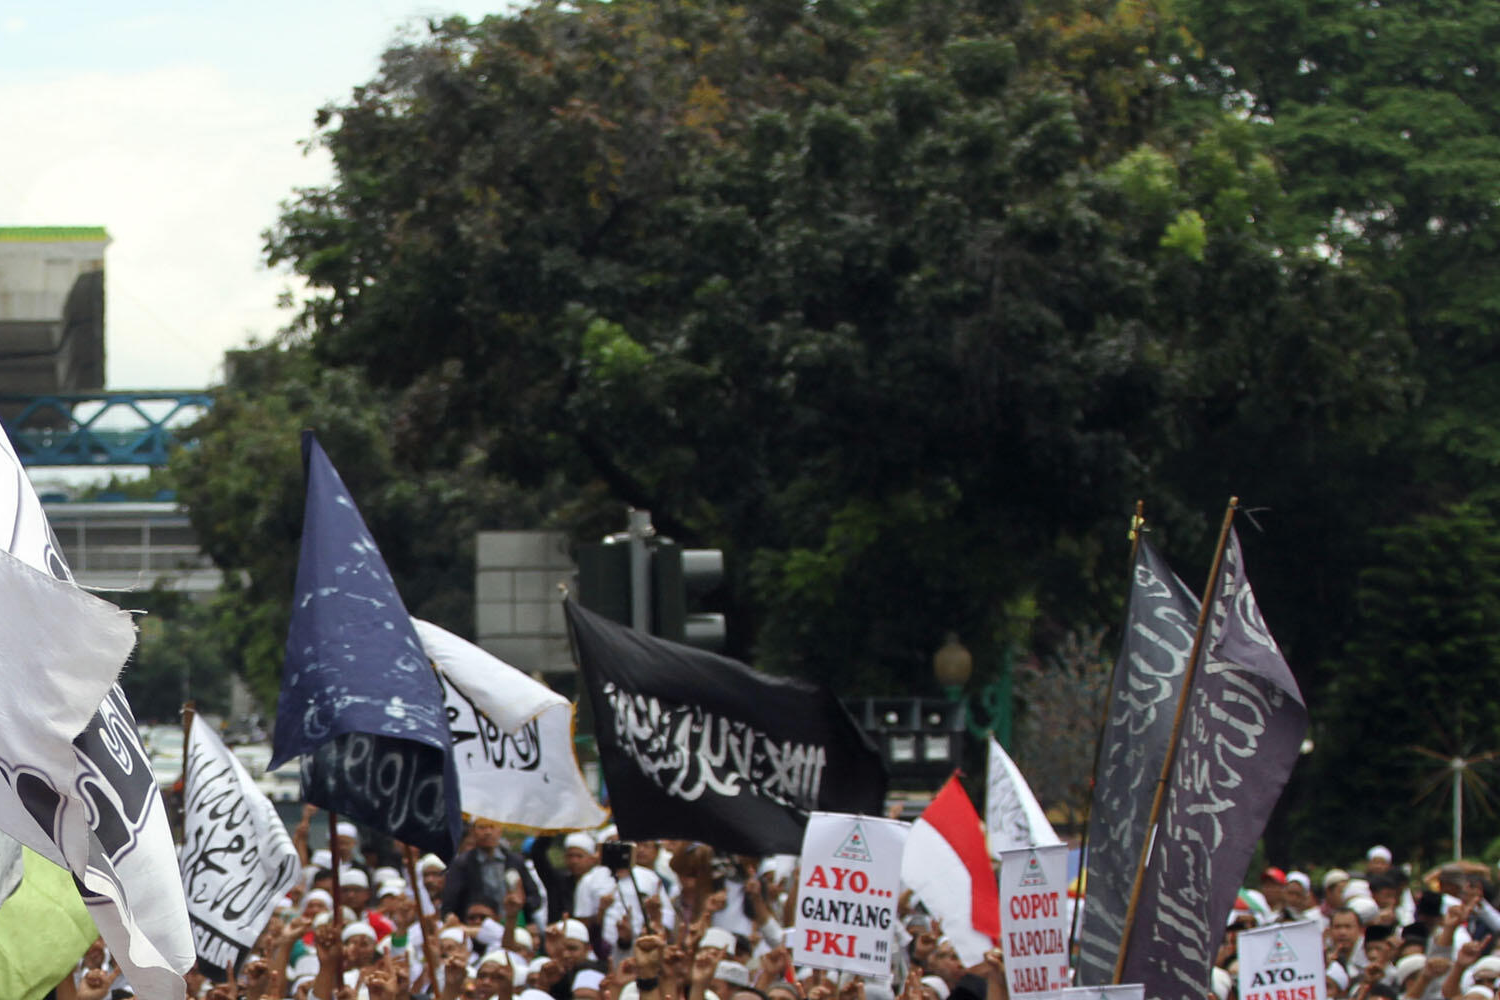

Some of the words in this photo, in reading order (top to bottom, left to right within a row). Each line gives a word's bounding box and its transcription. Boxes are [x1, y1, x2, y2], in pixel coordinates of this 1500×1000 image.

[802, 896, 891, 930] GANYANG
[1010, 892, 1059, 920] COPOT
[1008, 928, 1064, 957] KAPOLDA
